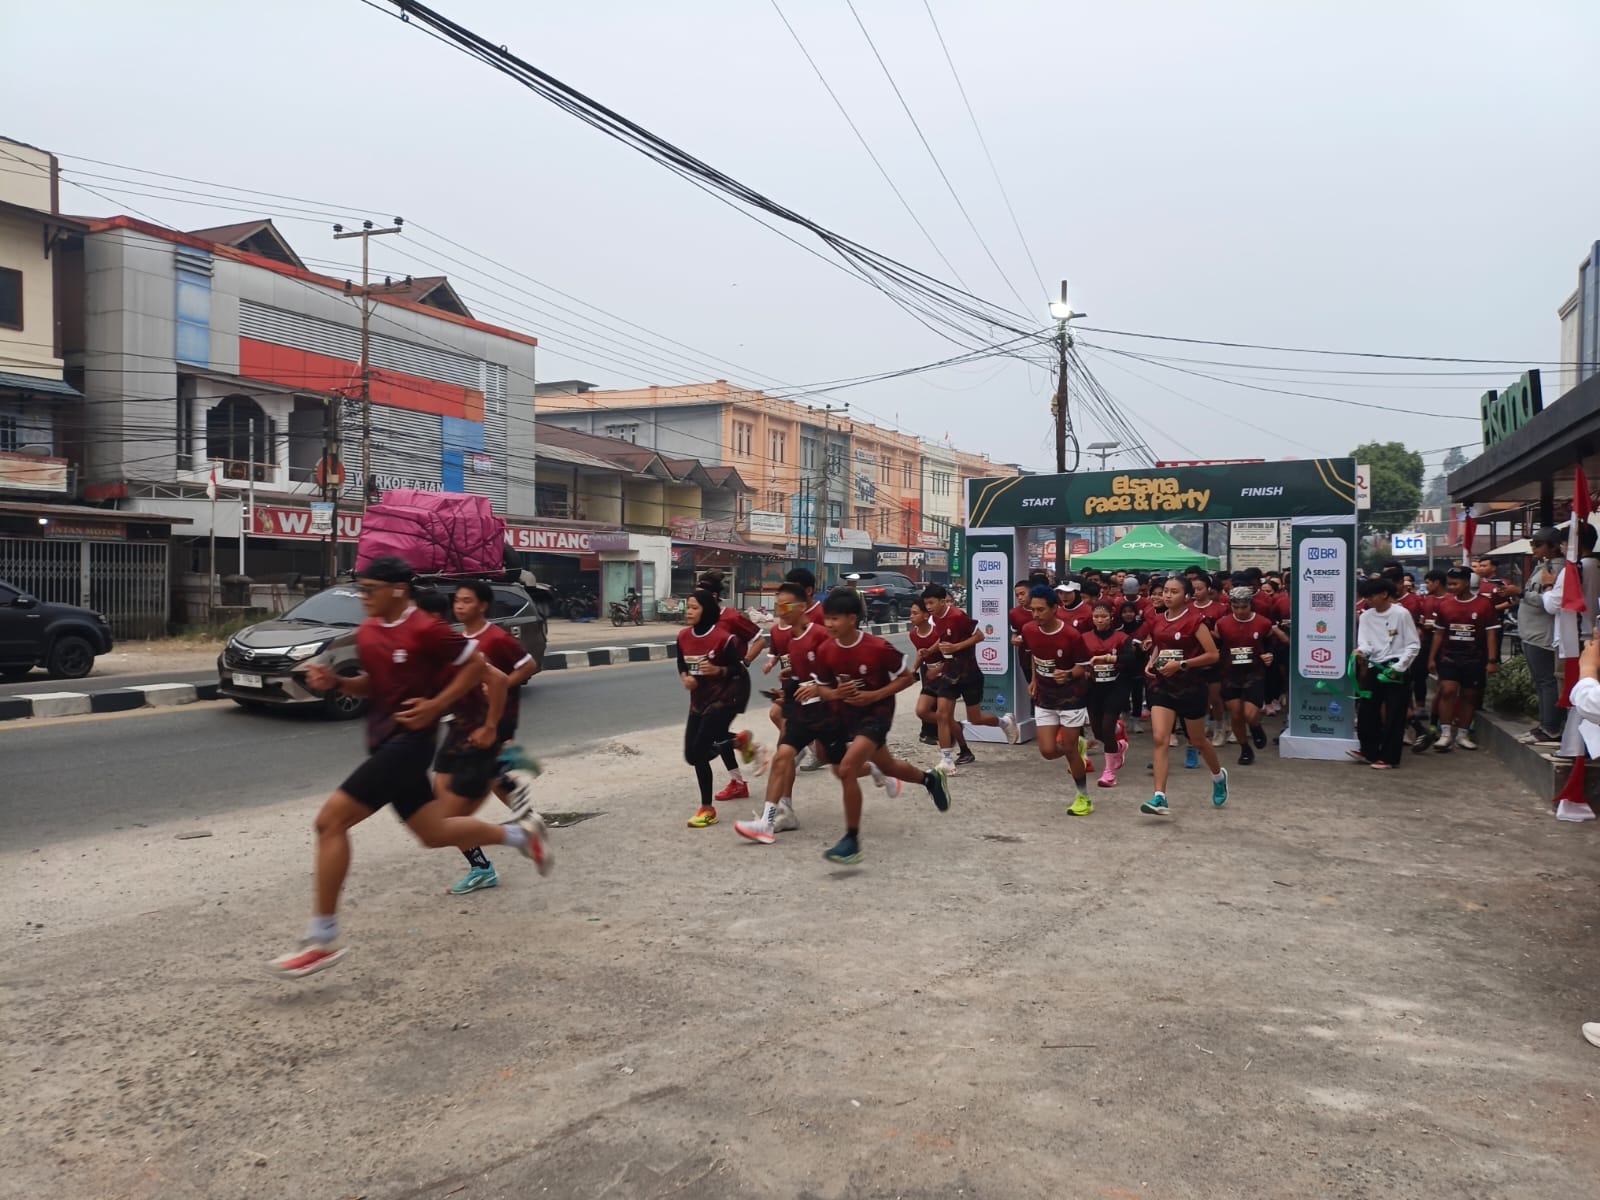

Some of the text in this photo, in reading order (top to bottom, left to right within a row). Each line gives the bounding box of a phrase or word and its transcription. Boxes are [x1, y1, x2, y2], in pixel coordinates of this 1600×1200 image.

[354, 472, 411, 491] WRKOP
[1112, 475, 1179, 495] Elsana
[1240, 486, 1283, 497] FINISH
[1022, 498, 1056, 507] START
[1085, 488, 1211, 516] Pace & Party
[519, 530, 590, 549] SINTANG
[1395, 536, 1423, 549] btn
[1320, 548, 1337, 558] BRI
[988, 561, 1001, 570] BRI
